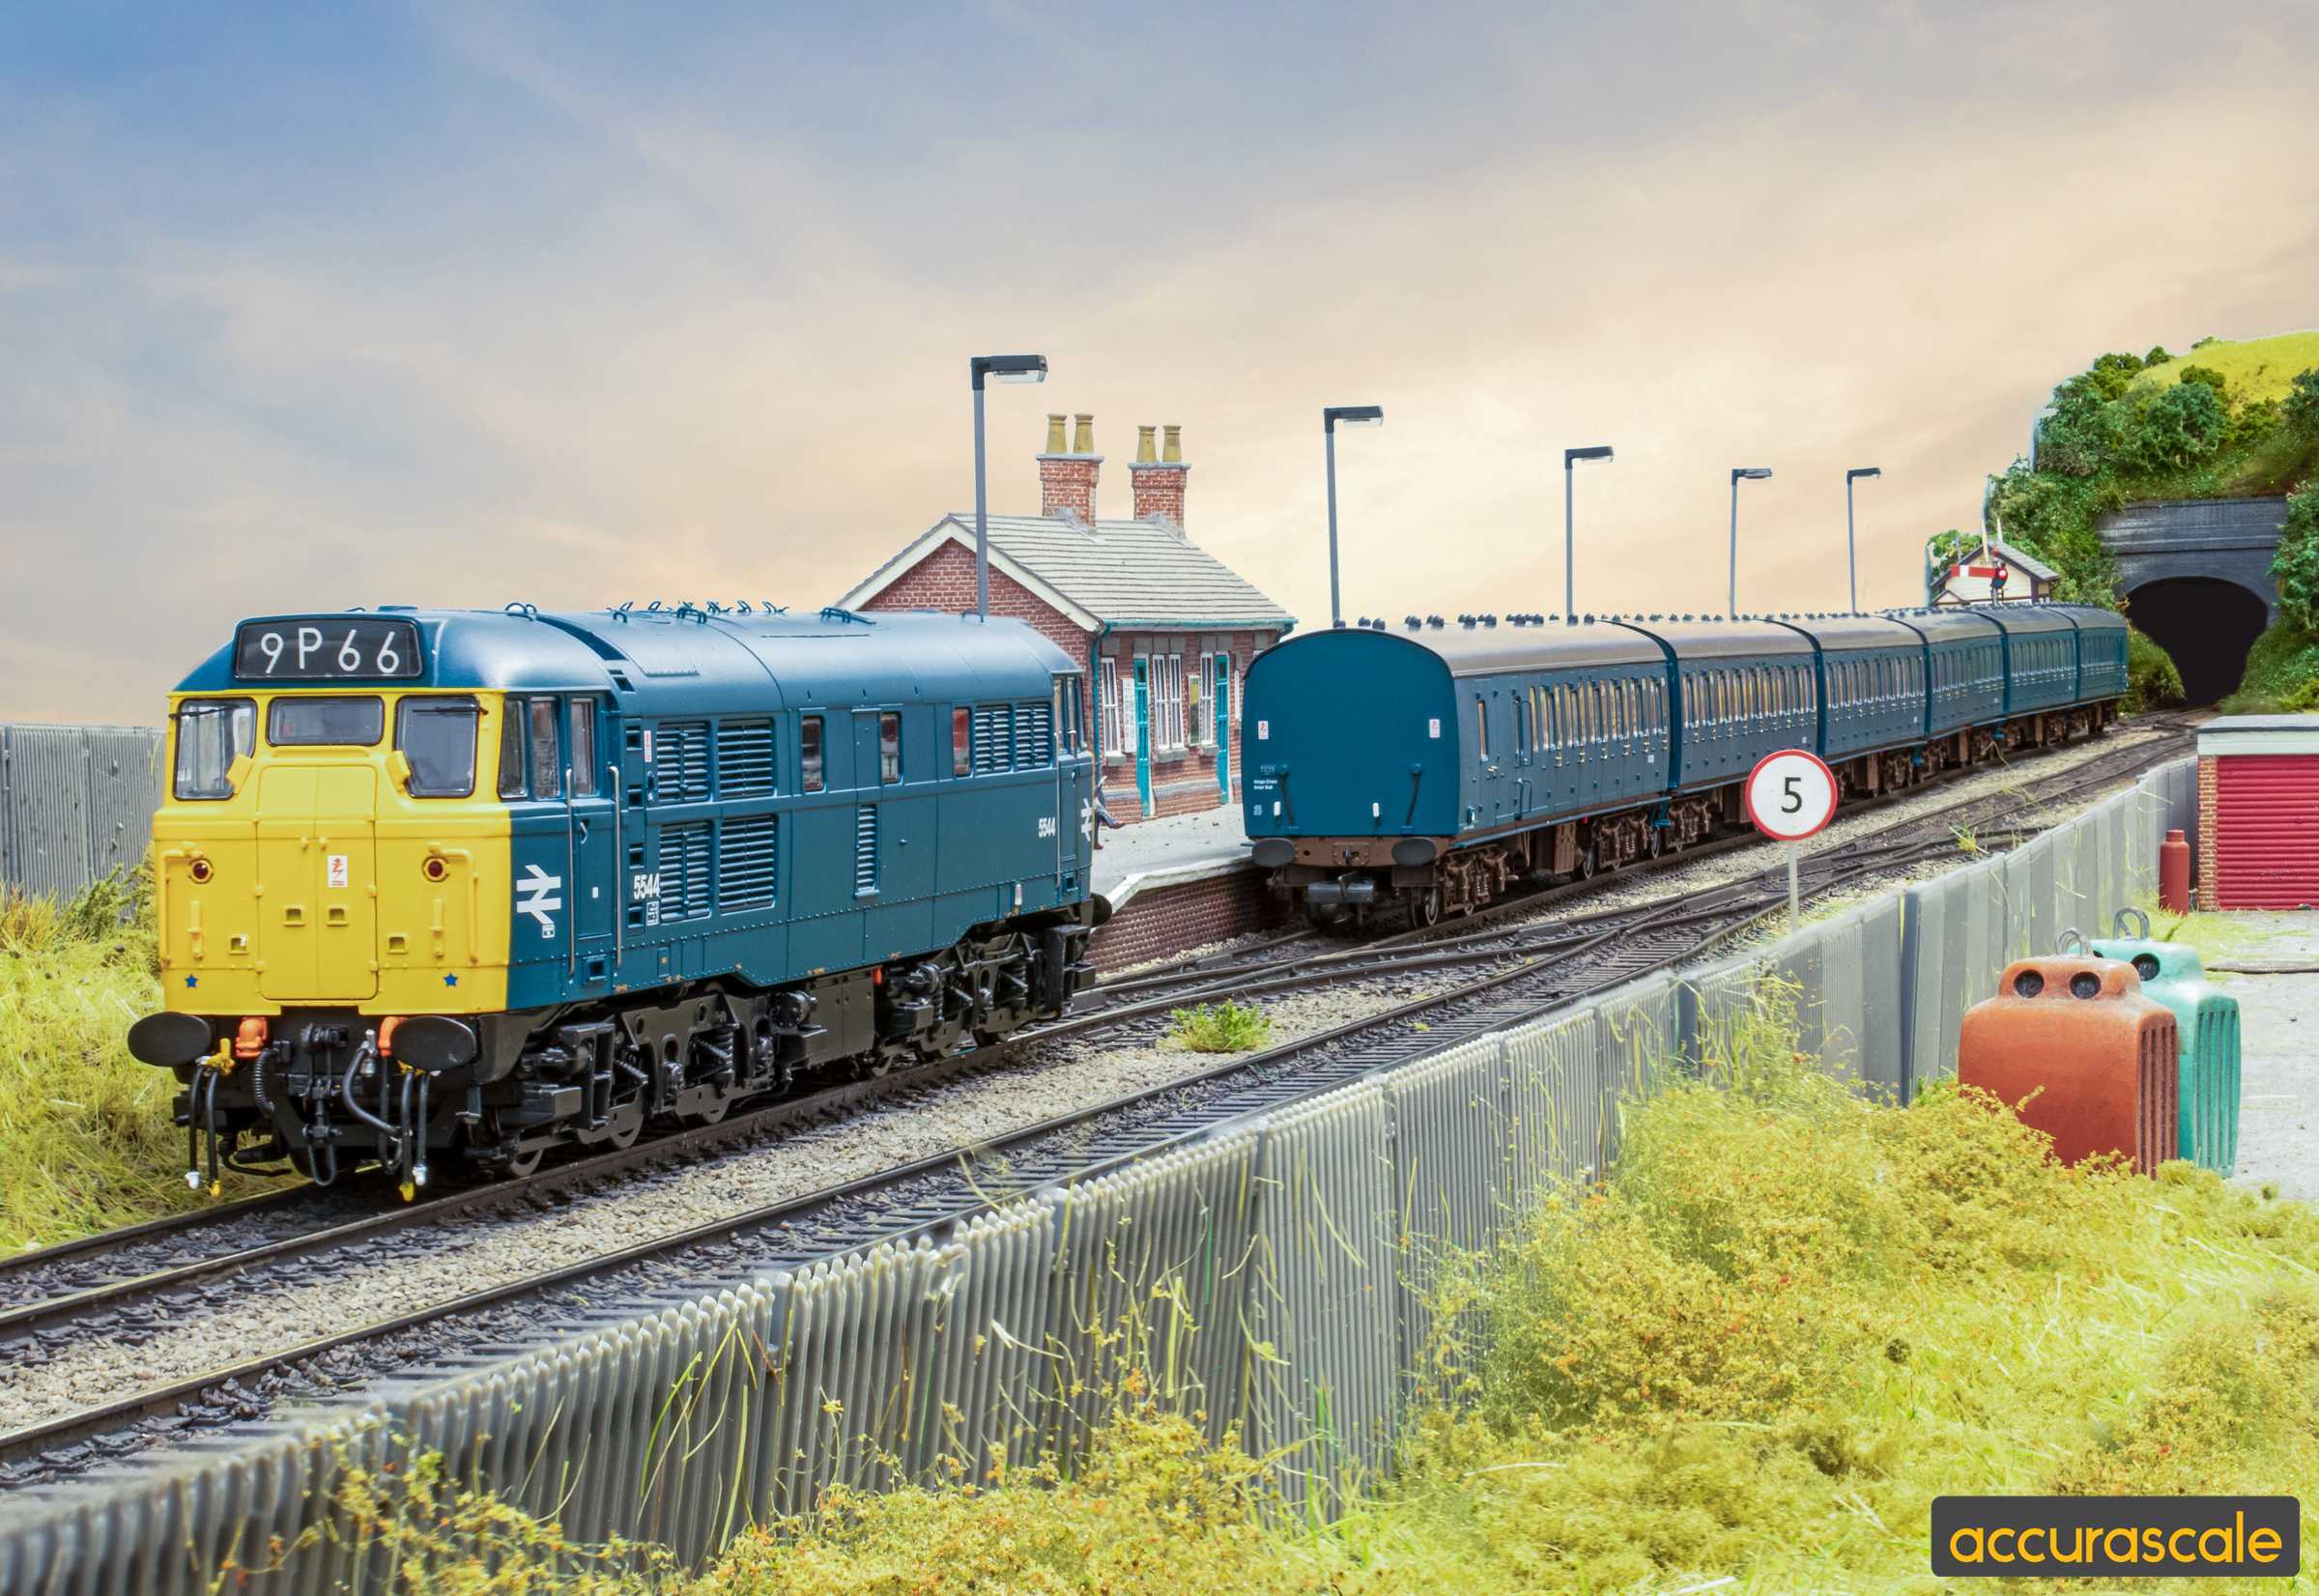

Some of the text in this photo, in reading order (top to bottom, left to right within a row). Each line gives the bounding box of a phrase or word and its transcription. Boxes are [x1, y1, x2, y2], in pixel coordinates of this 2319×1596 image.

[1781, 777, 1802, 813] 5
[1038, 817, 1056, 838] 5544
[633, 872, 661, 900] 5544
